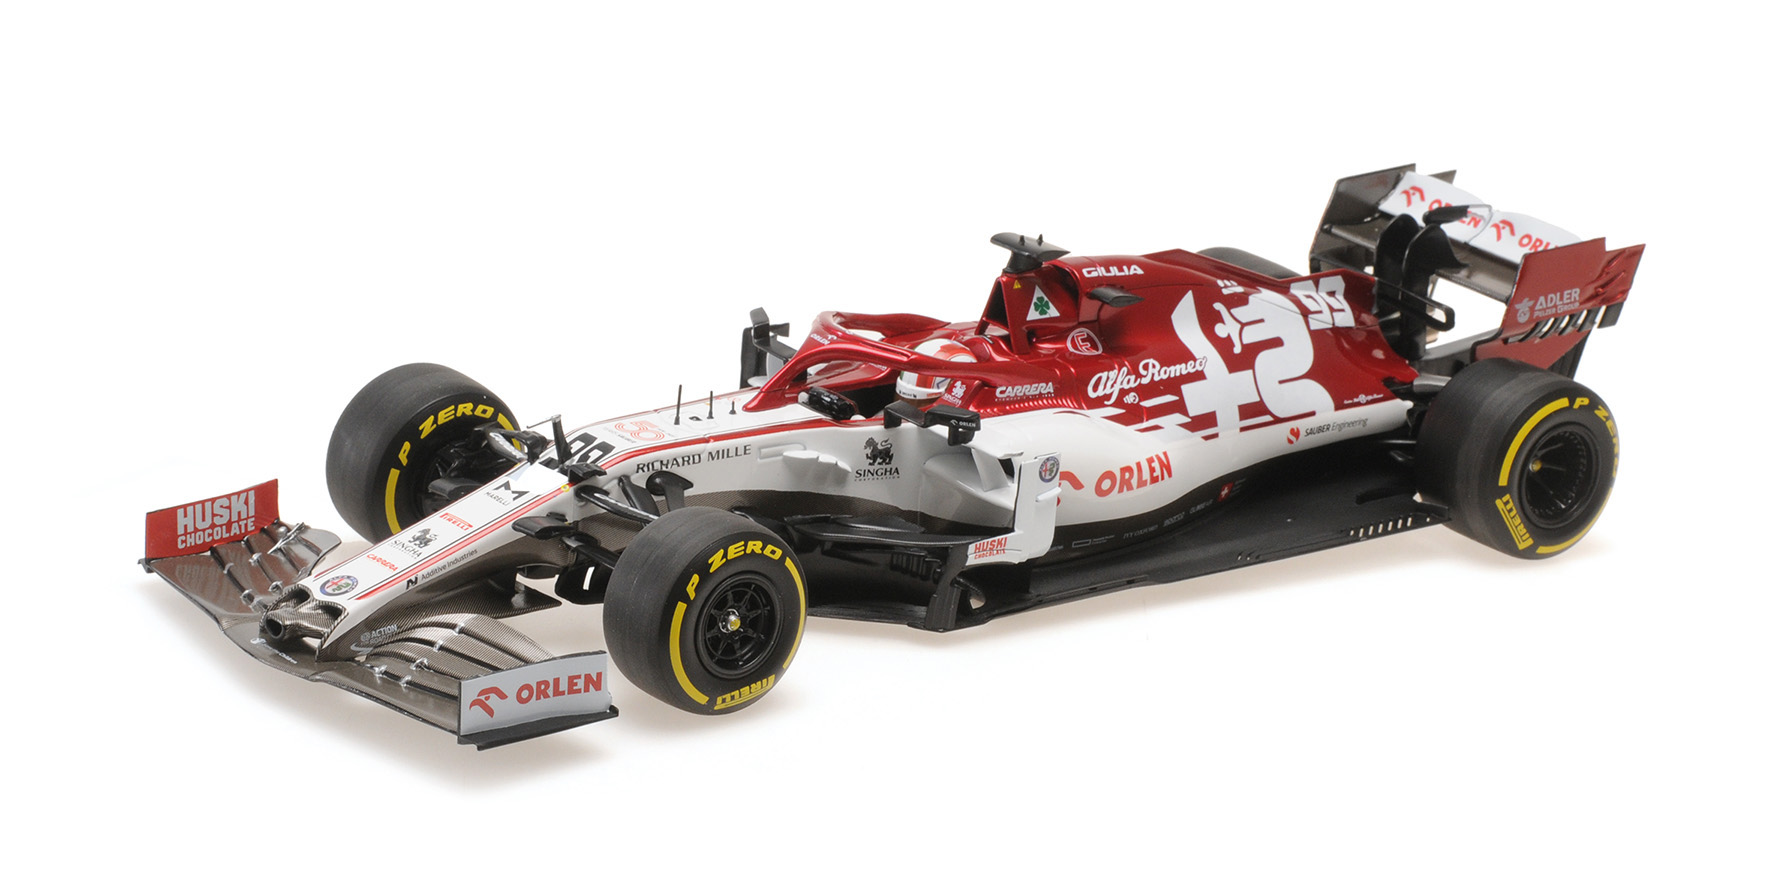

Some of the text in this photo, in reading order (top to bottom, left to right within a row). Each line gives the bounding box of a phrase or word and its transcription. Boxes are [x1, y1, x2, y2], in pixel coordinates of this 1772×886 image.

[1082, 264, 1144, 278] GIULIA
[1290, 275, 1356, 331] 99
[1534, 287, 1580, 310] ADLER
[995, 381, 1054, 398] CARRERA
[1087, 366, 1141, 405] Alfa
[1138, 358, 1208, 384] Romeo
[418, 402, 495, 439] ZERO
[1304, 418, 1368, 437] SAUBER Engineering
[635, 444, 752, 474] RICHARD MILLE
[855, 467, 900, 479] SINGHA
[1094, 451, 1173, 498] ORLEN
[177, 490, 256, 536] HUSKI
[439, 512, 474, 531] PIRELLI
[1495, 493, 1535, 551] PIRELLI
[177, 517, 256, 550] CHOCOLATE
[392, 539, 423, 558] SINGHA
[974, 536, 1008, 553] HUSKI
[366, 553, 399, 572] CARRERA
[421, 564, 447, 581] Additive
[446, 548, 479, 568] Industries
[708, 540, 783, 573] ZERO
[370, 623, 399, 639] ACTION
[515, 671, 603, 704] ORLEN
[714, 674, 776, 710] PIRELLI
